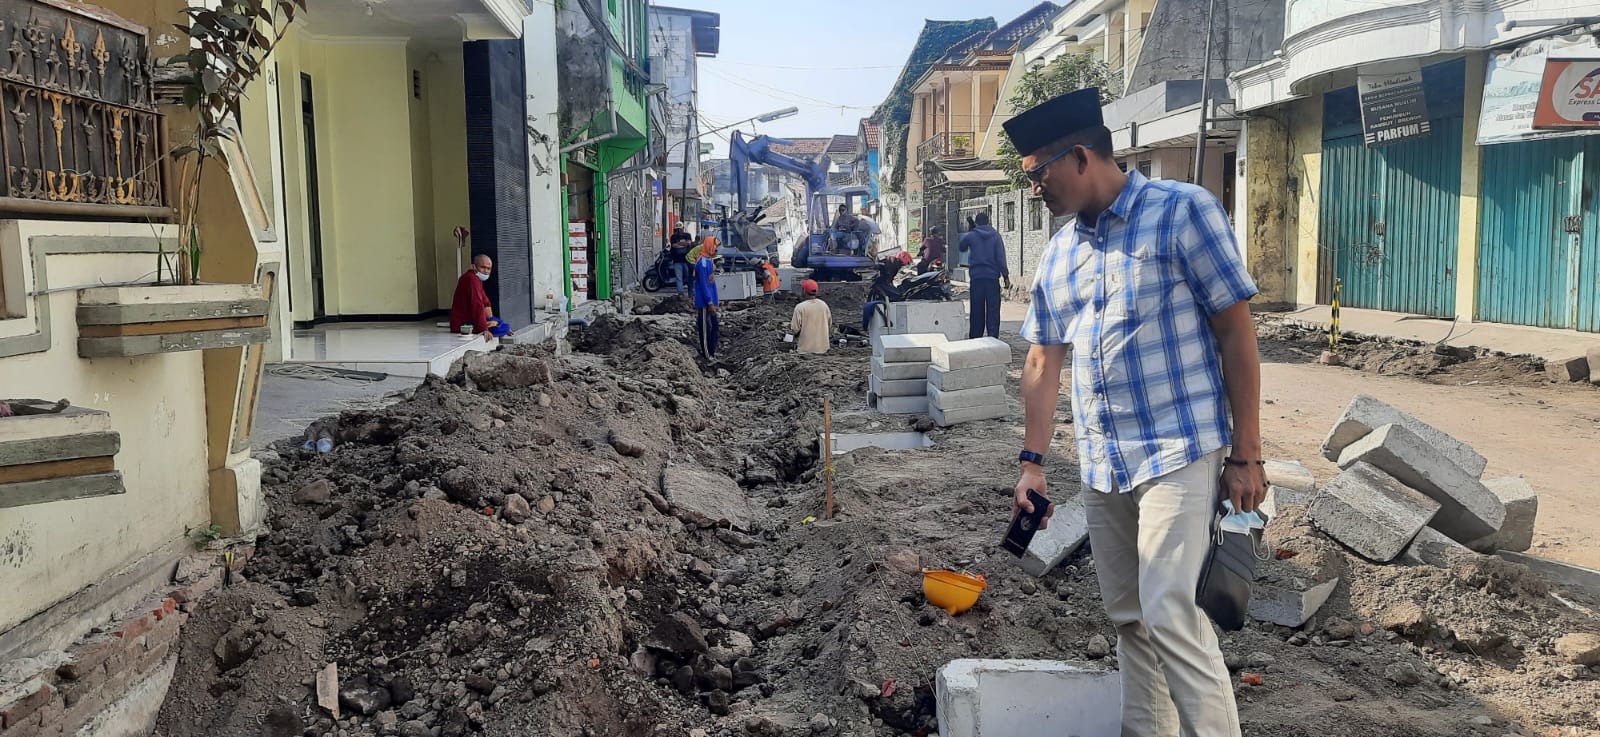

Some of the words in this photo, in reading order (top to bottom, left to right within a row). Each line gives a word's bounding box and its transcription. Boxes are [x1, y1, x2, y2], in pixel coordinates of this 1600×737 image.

[267, 69, 275, 86] 24
[1567, 98, 1595, 106] Express
[1370, 103, 1394, 112] BUSANA
[1370, 120, 1393, 129] RAMBUT
[1376, 124, 1419, 142] PARFUM
